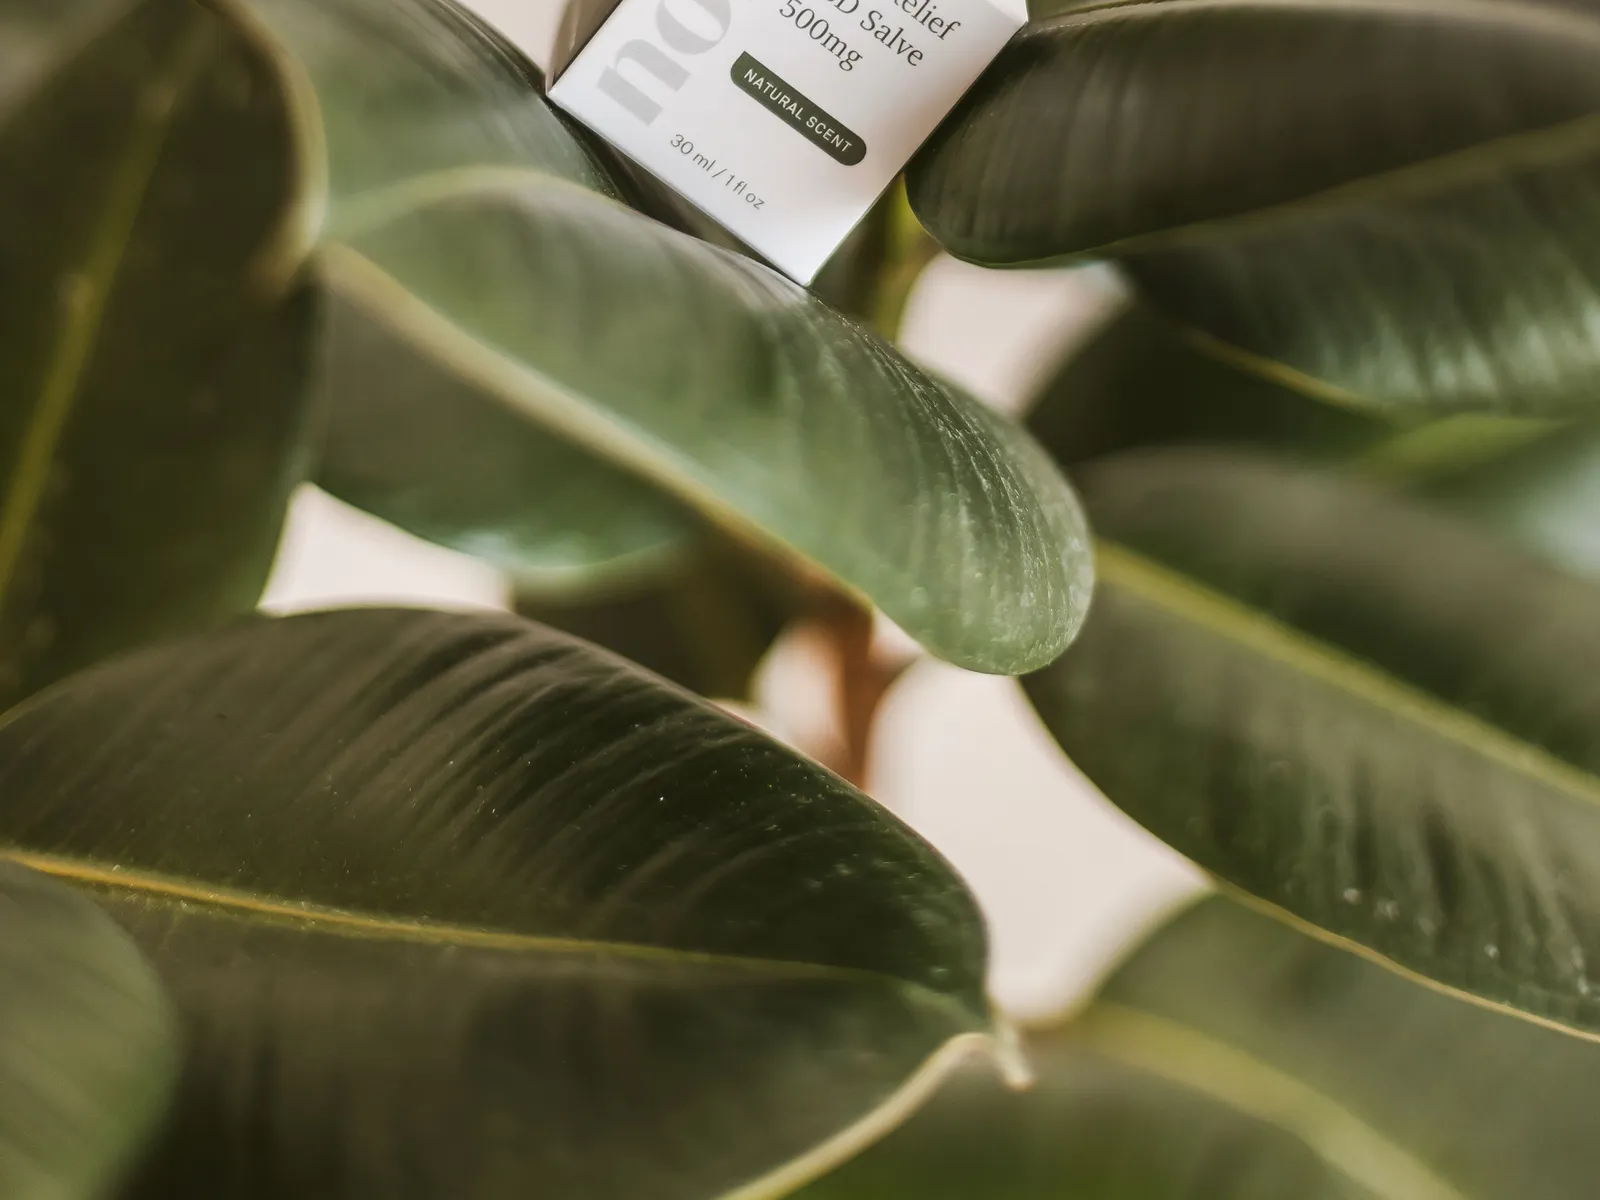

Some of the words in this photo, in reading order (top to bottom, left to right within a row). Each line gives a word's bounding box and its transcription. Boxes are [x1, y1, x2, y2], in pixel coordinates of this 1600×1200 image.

[860, 9, 925, 67] Salve
[744, 69, 803, 121] NATURAL
[806, 116, 853, 152] SCENT
[670, 133, 694, 155] 30
[692, 153, 716, 172] ml
[711, 168, 727, 179] /
[745, 192, 766, 210] oz
